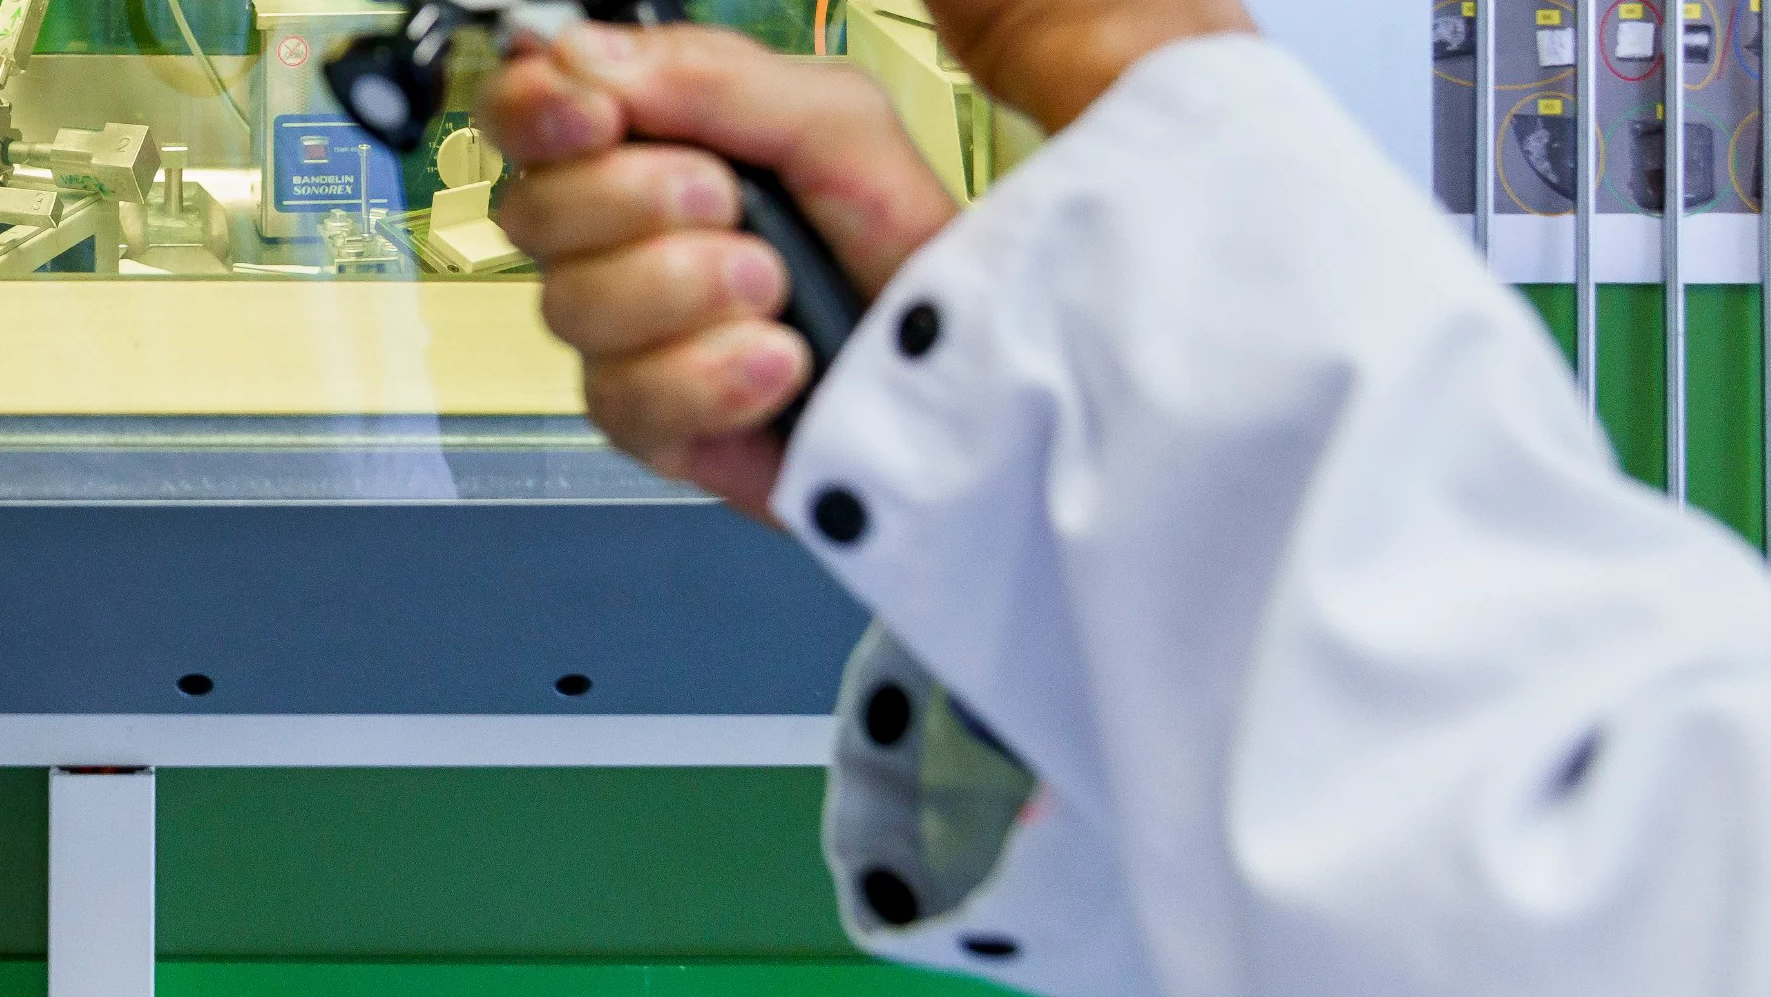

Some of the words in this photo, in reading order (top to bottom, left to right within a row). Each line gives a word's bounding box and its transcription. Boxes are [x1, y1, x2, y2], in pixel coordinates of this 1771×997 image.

[116, 137, 130, 153] 2
[292, 174, 354, 185] BANDELIN
[292, 184, 353, 196] SONOREX
